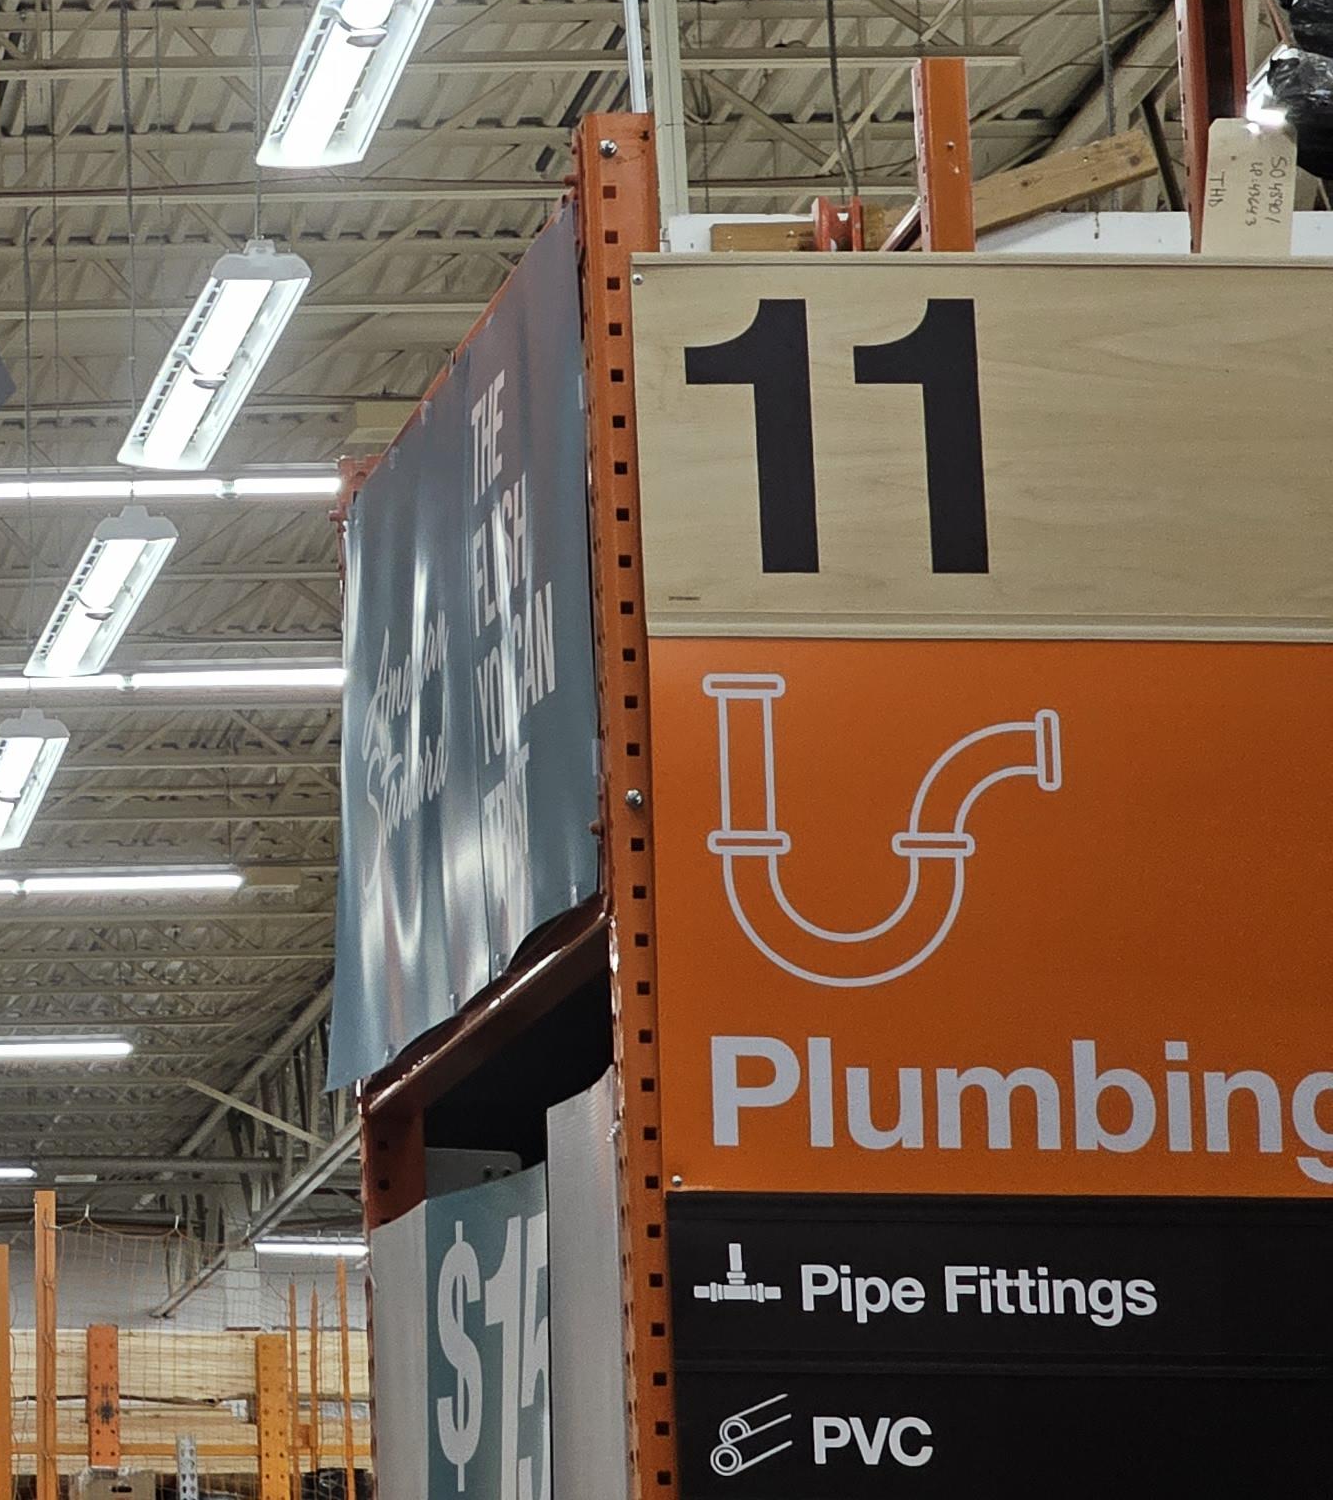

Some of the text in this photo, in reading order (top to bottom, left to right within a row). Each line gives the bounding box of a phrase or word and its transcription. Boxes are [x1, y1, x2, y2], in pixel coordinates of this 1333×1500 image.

[471, 368, 505, 506] THE
[684, 298, 989, 574] 11
[361, 610, 449, 762] Amean
[512, 581, 556, 726] CAN
[710, 1036, 1333, 1184] Plumbing
[800, 1264, 1158, 1327] Pipe Fittings
[812, 1416, 933, 1468] PVC
